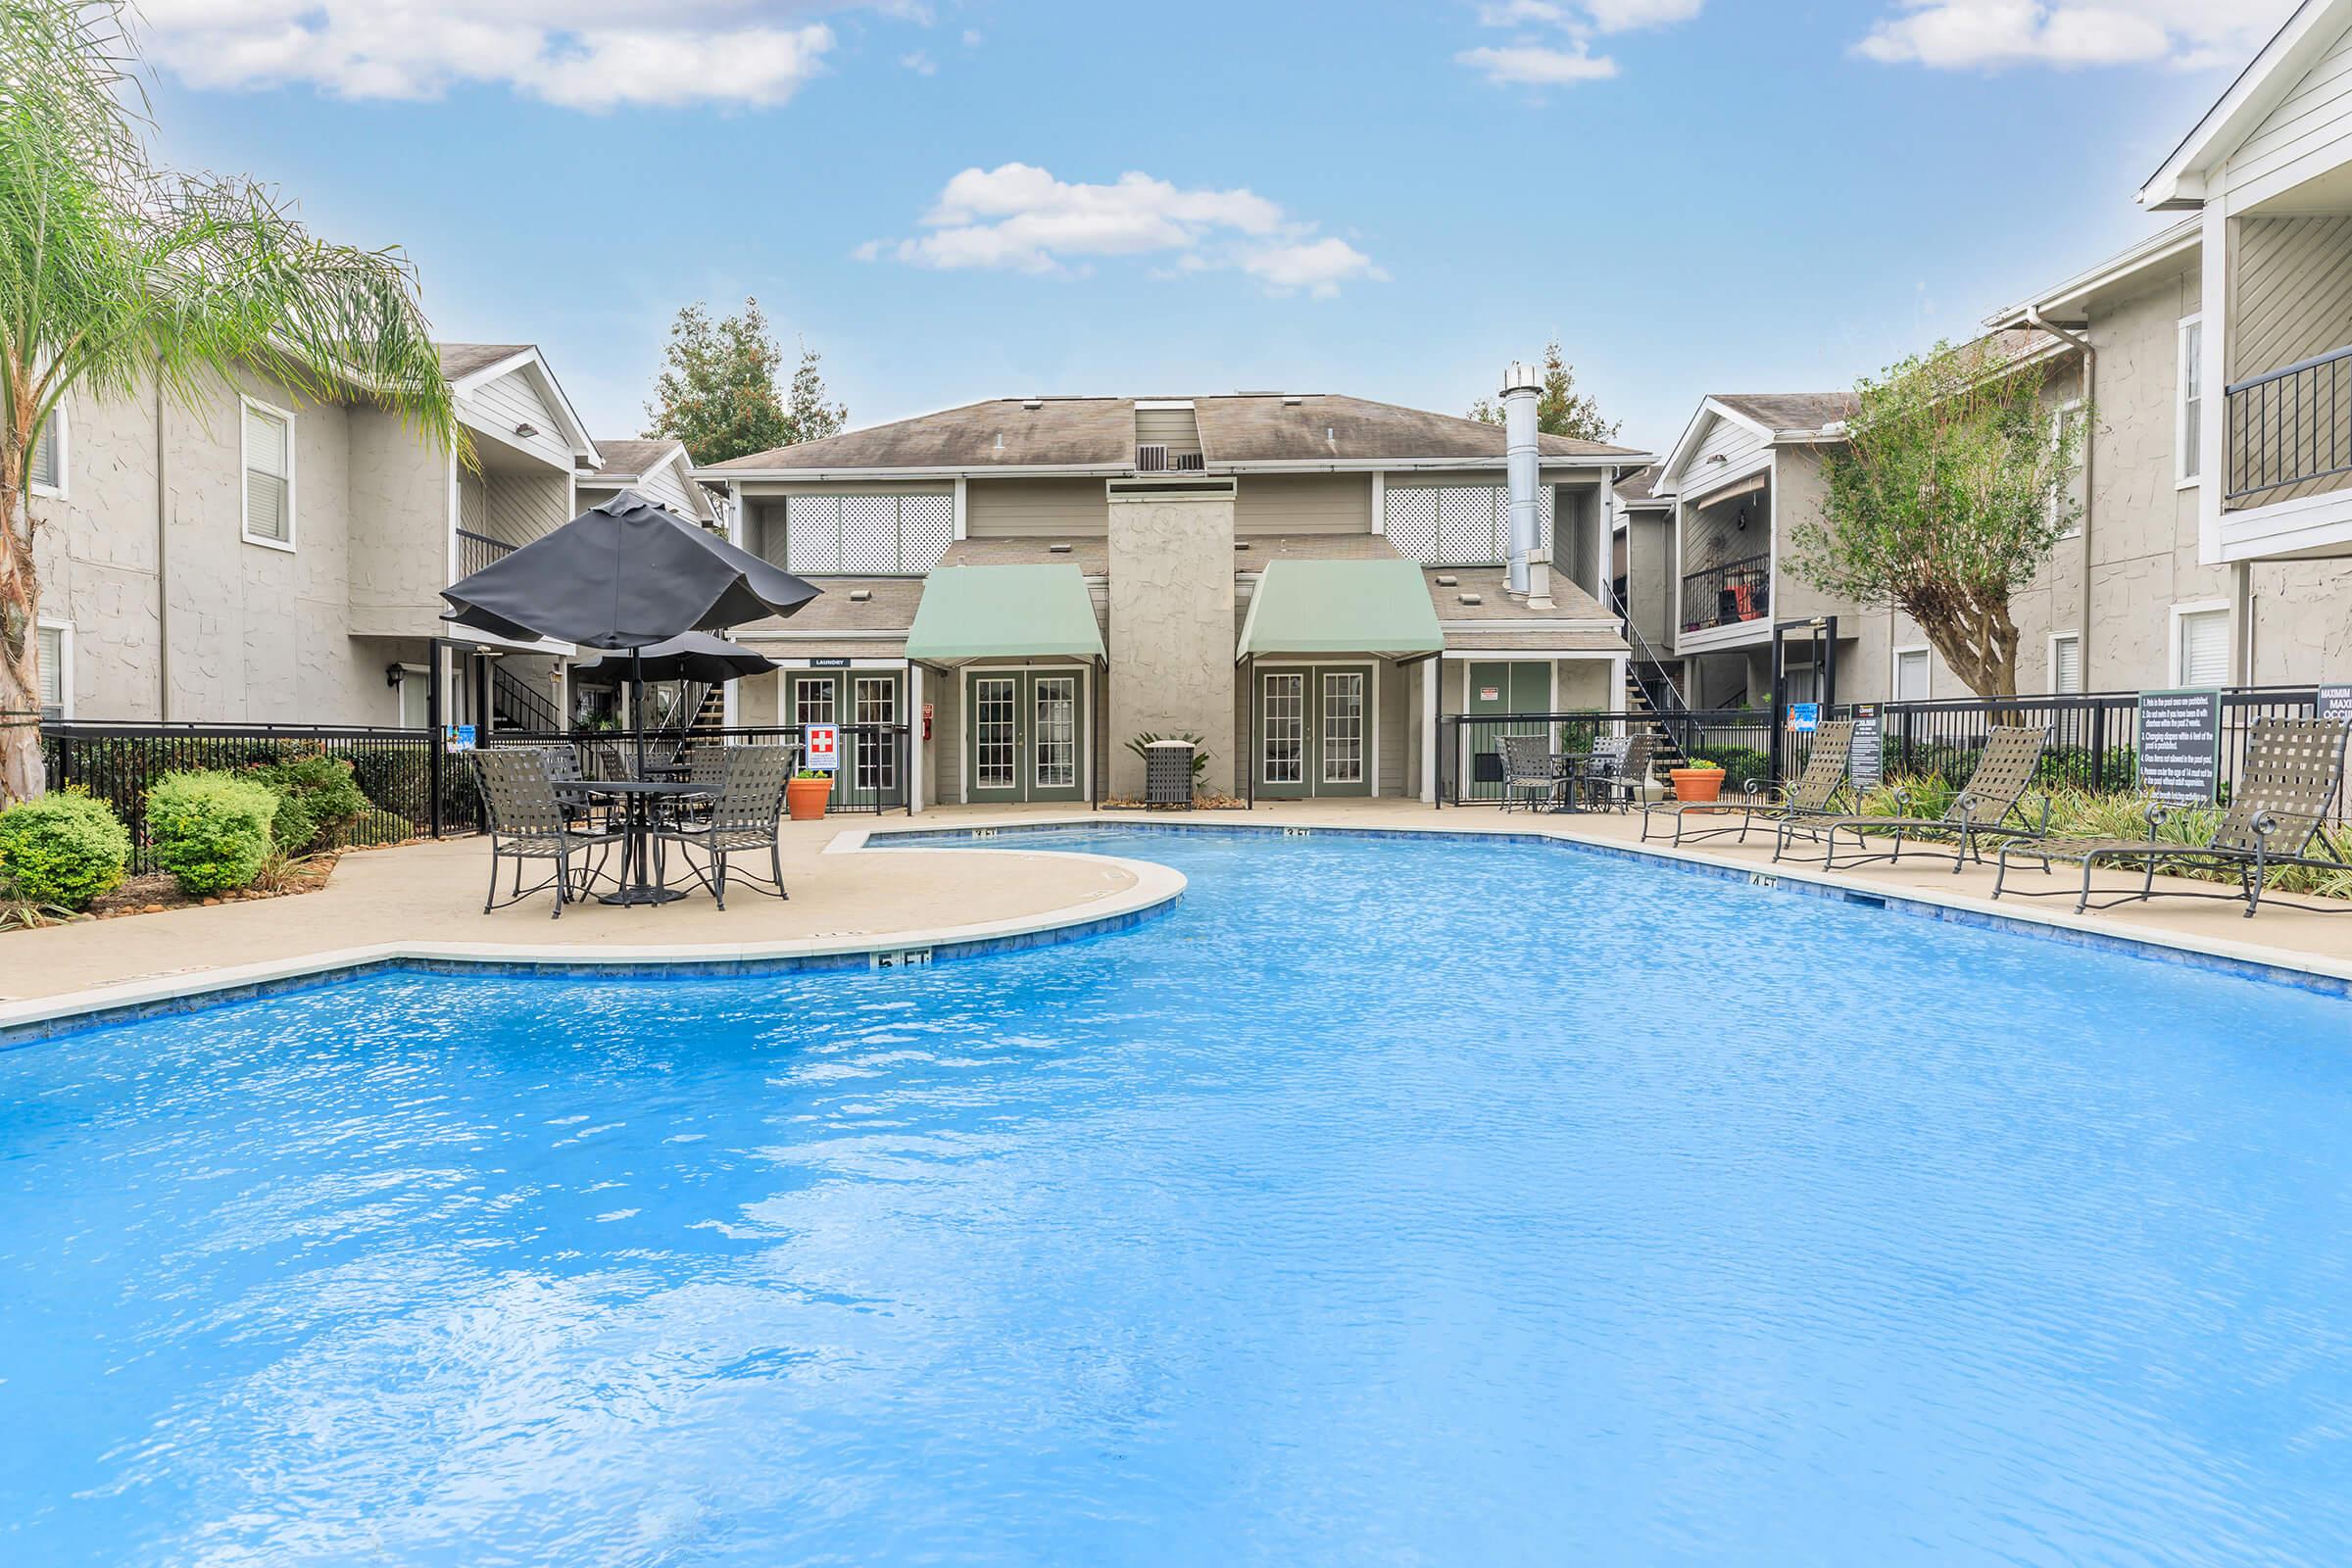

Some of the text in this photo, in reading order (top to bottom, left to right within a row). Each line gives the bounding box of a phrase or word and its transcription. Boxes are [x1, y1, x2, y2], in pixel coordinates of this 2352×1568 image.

[2321, 689, 2350, 699] MAXIMUM
[1764, 877, 1777, 887] FT
[878, 955, 893, 968] 5
